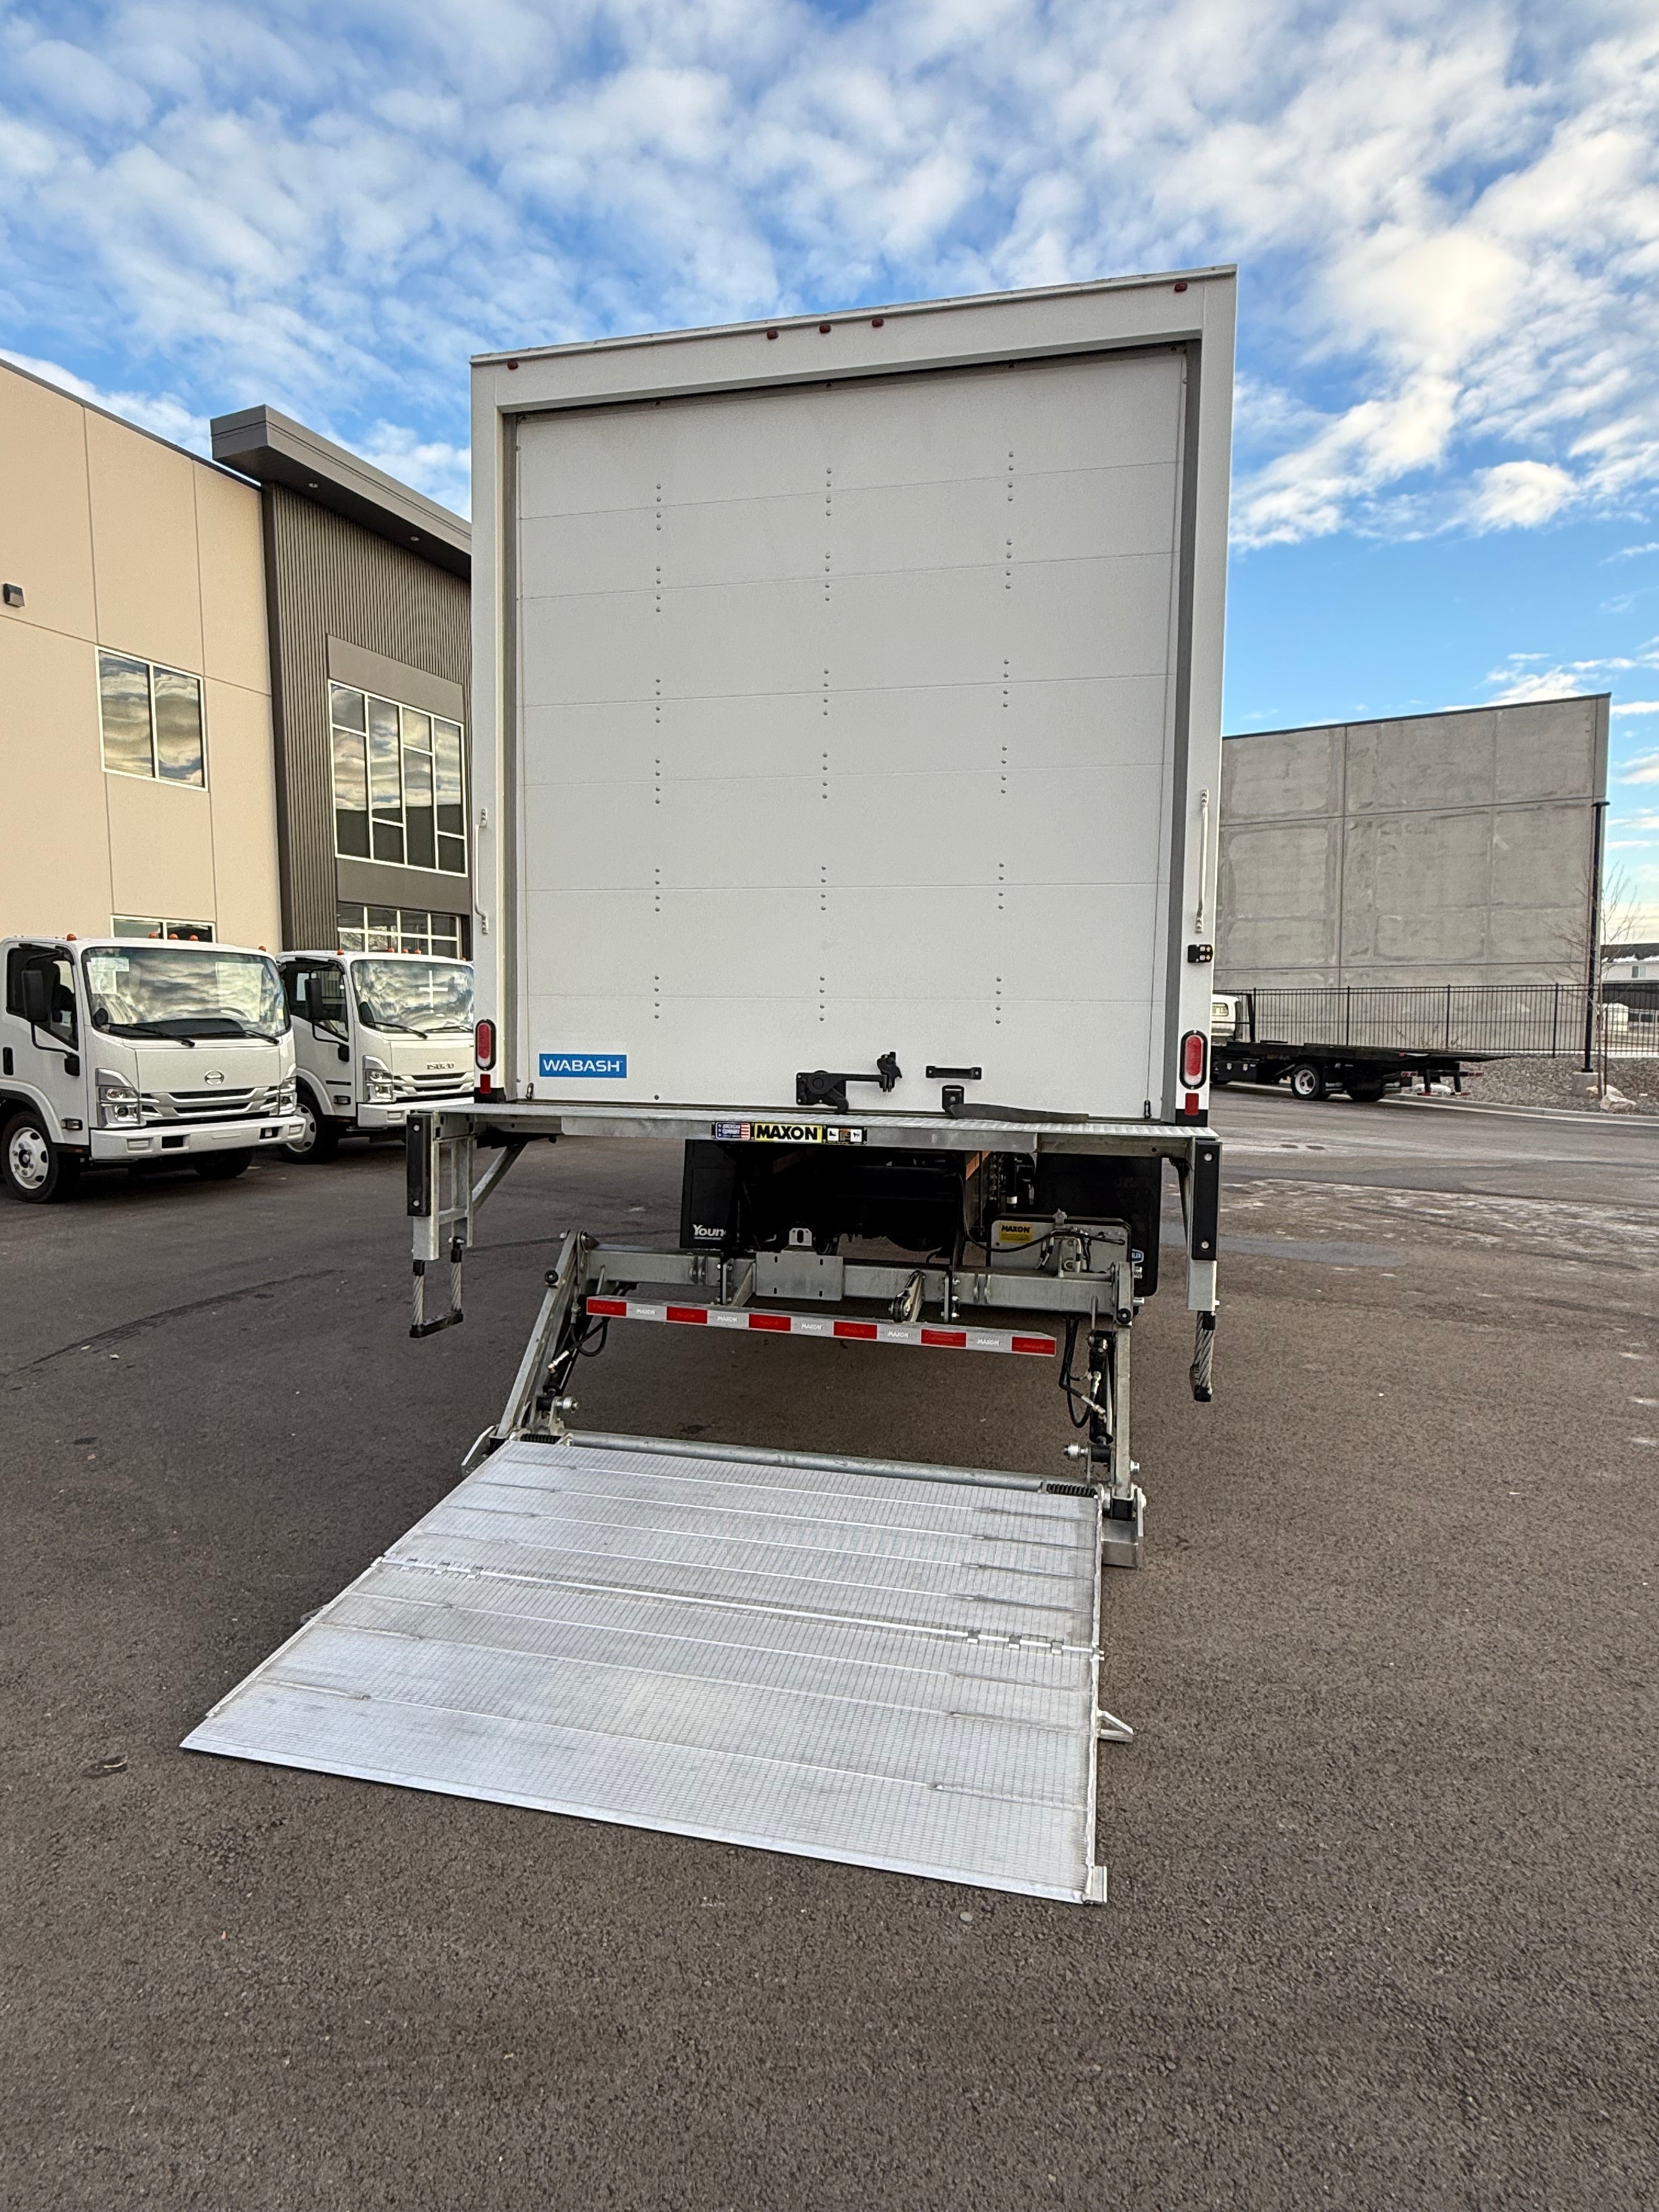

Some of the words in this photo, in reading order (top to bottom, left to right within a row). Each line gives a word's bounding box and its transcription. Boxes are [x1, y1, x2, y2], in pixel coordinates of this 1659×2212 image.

[543, 1059, 620, 1072] WABASH
[756, 1125, 817, 1140] MAXON
[693, 1224, 726, 1237] Youn
[1001, 1225, 1031, 1233] MAXON
